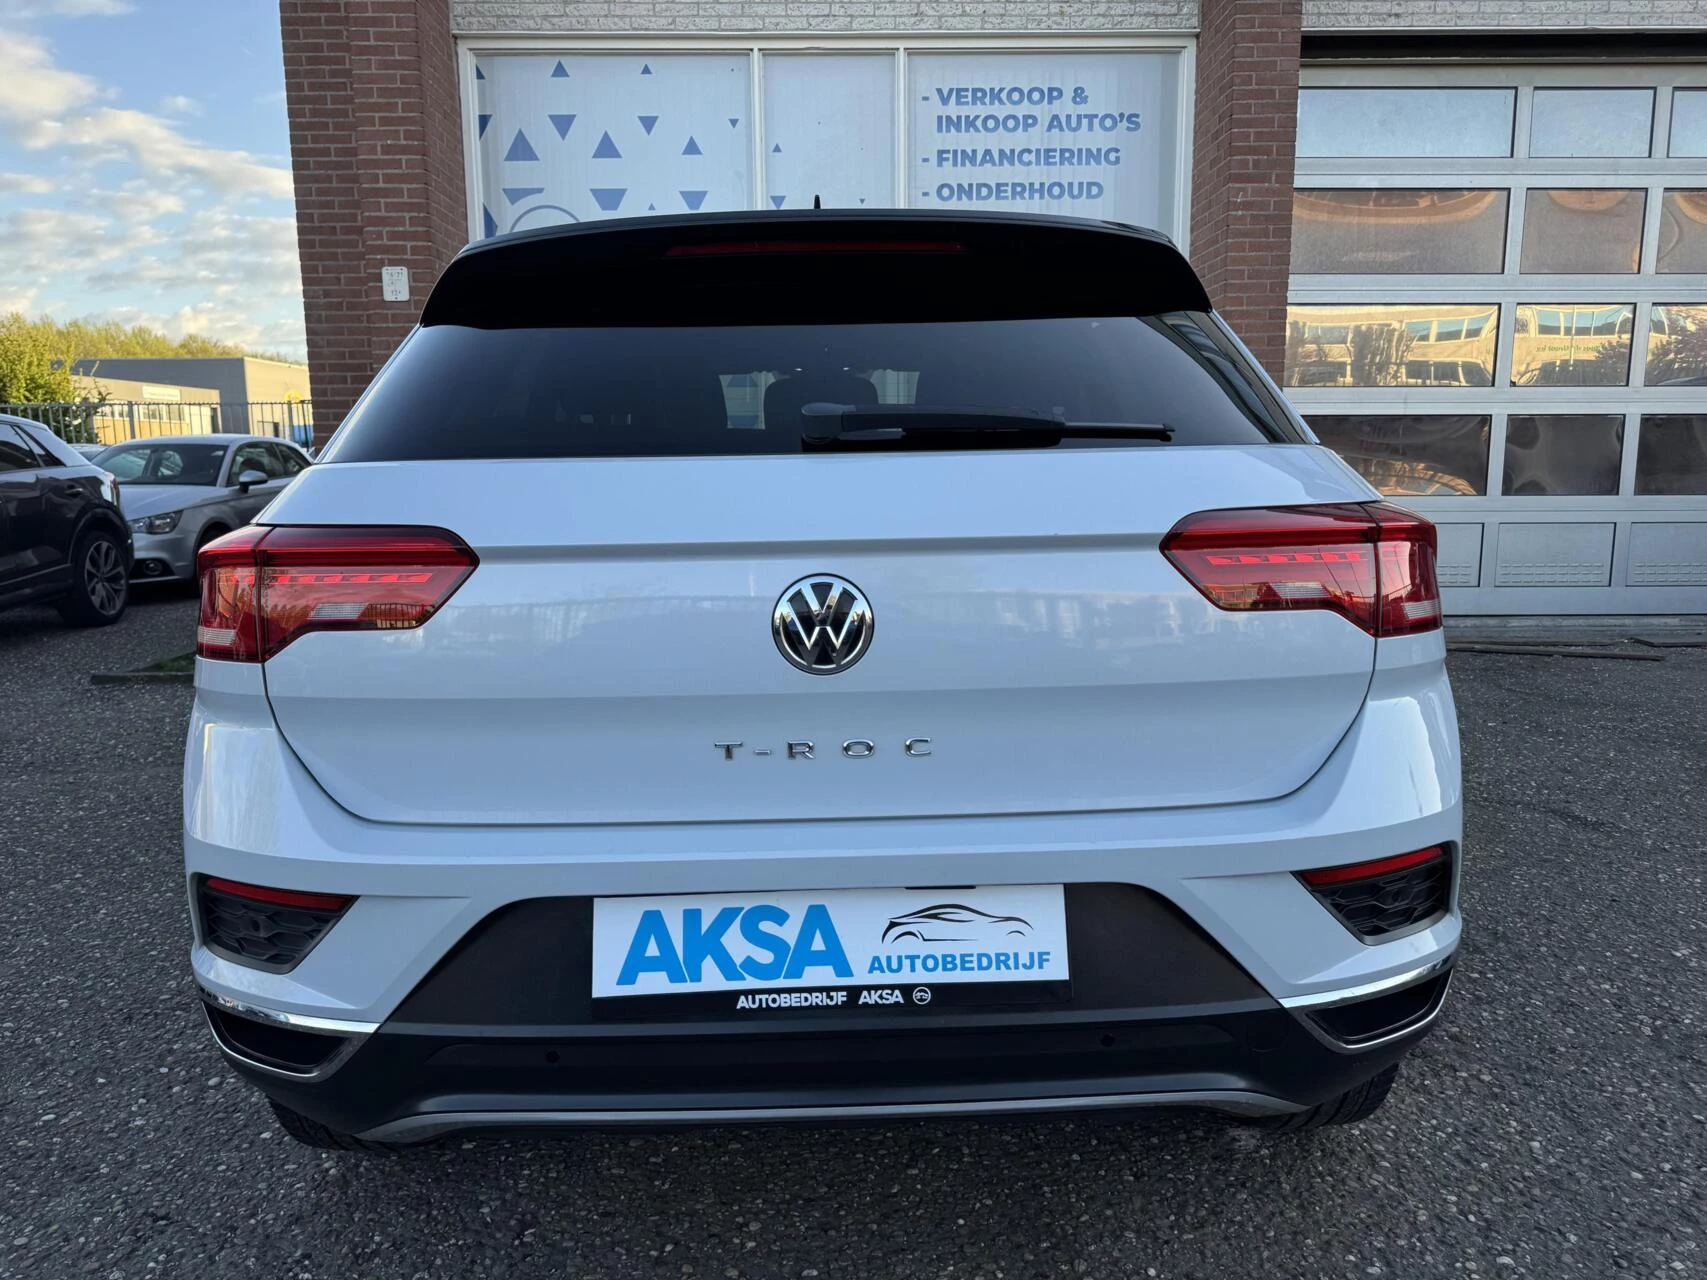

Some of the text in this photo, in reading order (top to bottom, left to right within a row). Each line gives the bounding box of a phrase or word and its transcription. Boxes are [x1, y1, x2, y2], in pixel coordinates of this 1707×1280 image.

[935, 86, 1064, 106] VERKOOP
[1071, 86, 1089, 106] &
[936, 112, 1142, 133] INKOOP AUTO'S
[936, 147, 1121, 168] FINANCIERING
[936, 181, 1104, 202] ONDERHOUD
[714, 737, 932, 760] T-ROC
[616, 903, 854, 986] AKSA
[867, 951, 1051, 974] AUTOBEDRIJF
[736, 990, 905, 1009] AUTOBEDRIJF AKSA
